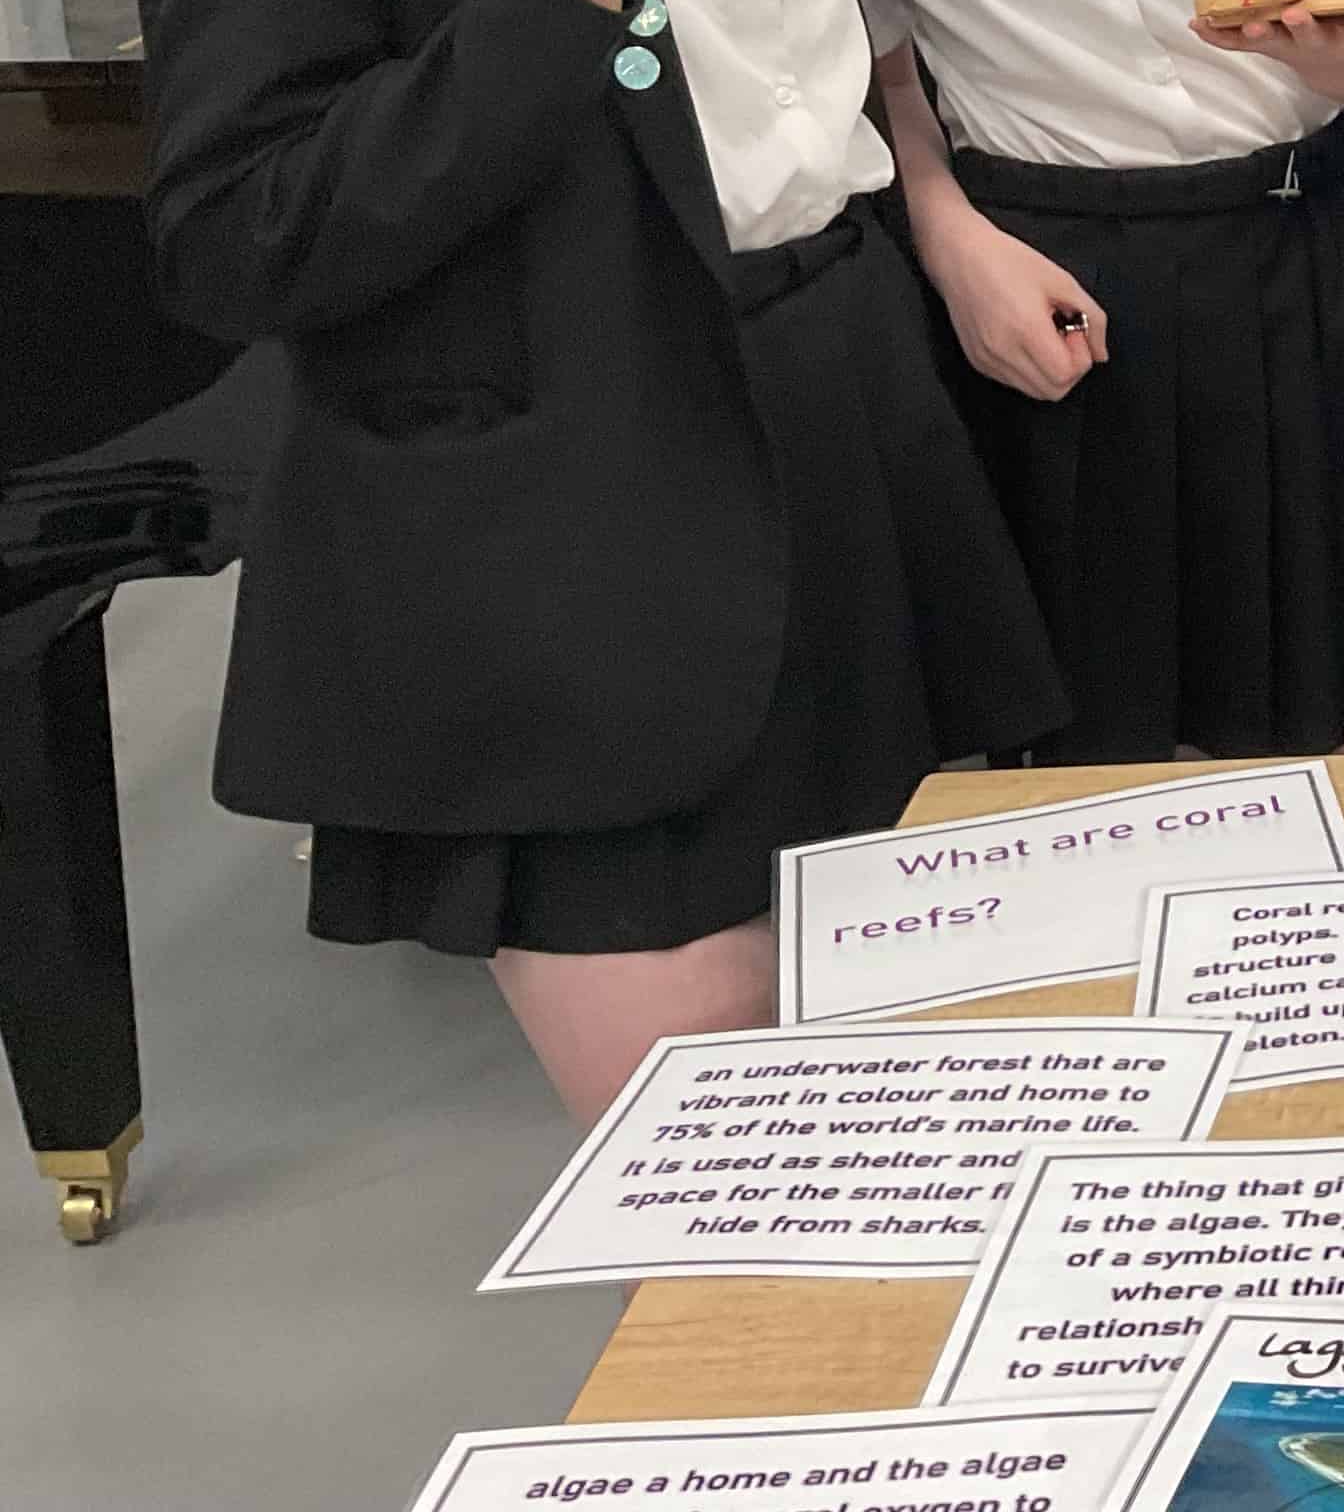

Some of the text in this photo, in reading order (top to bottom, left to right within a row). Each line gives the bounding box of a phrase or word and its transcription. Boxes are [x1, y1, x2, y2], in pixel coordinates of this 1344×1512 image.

[897, 794, 1287, 876] What are coral
[834, 897, 1003, 944] reefs?
[1232, 902, 1313, 922] Coral
[1193, 953, 1337, 978] structure
[693, 1053, 1166, 1083] an underwater forest that are
[679, 1083, 1150, 1112] vibrant in colour and home to
[1071, 1182, 1131, 1201] The
[1141, 1180, 1227, 1202] thing
[1237, 1179, 1305, 1197] that
[525, 1475, 634, 1503] algae
[645, 1476, 670, 1493] a
[679, 1469, 792, 1492] home
[802, 1460, 879, 1486] and
[887, 1457, 949, 1481] the
[960, 1451, 1067, 1480] algae
